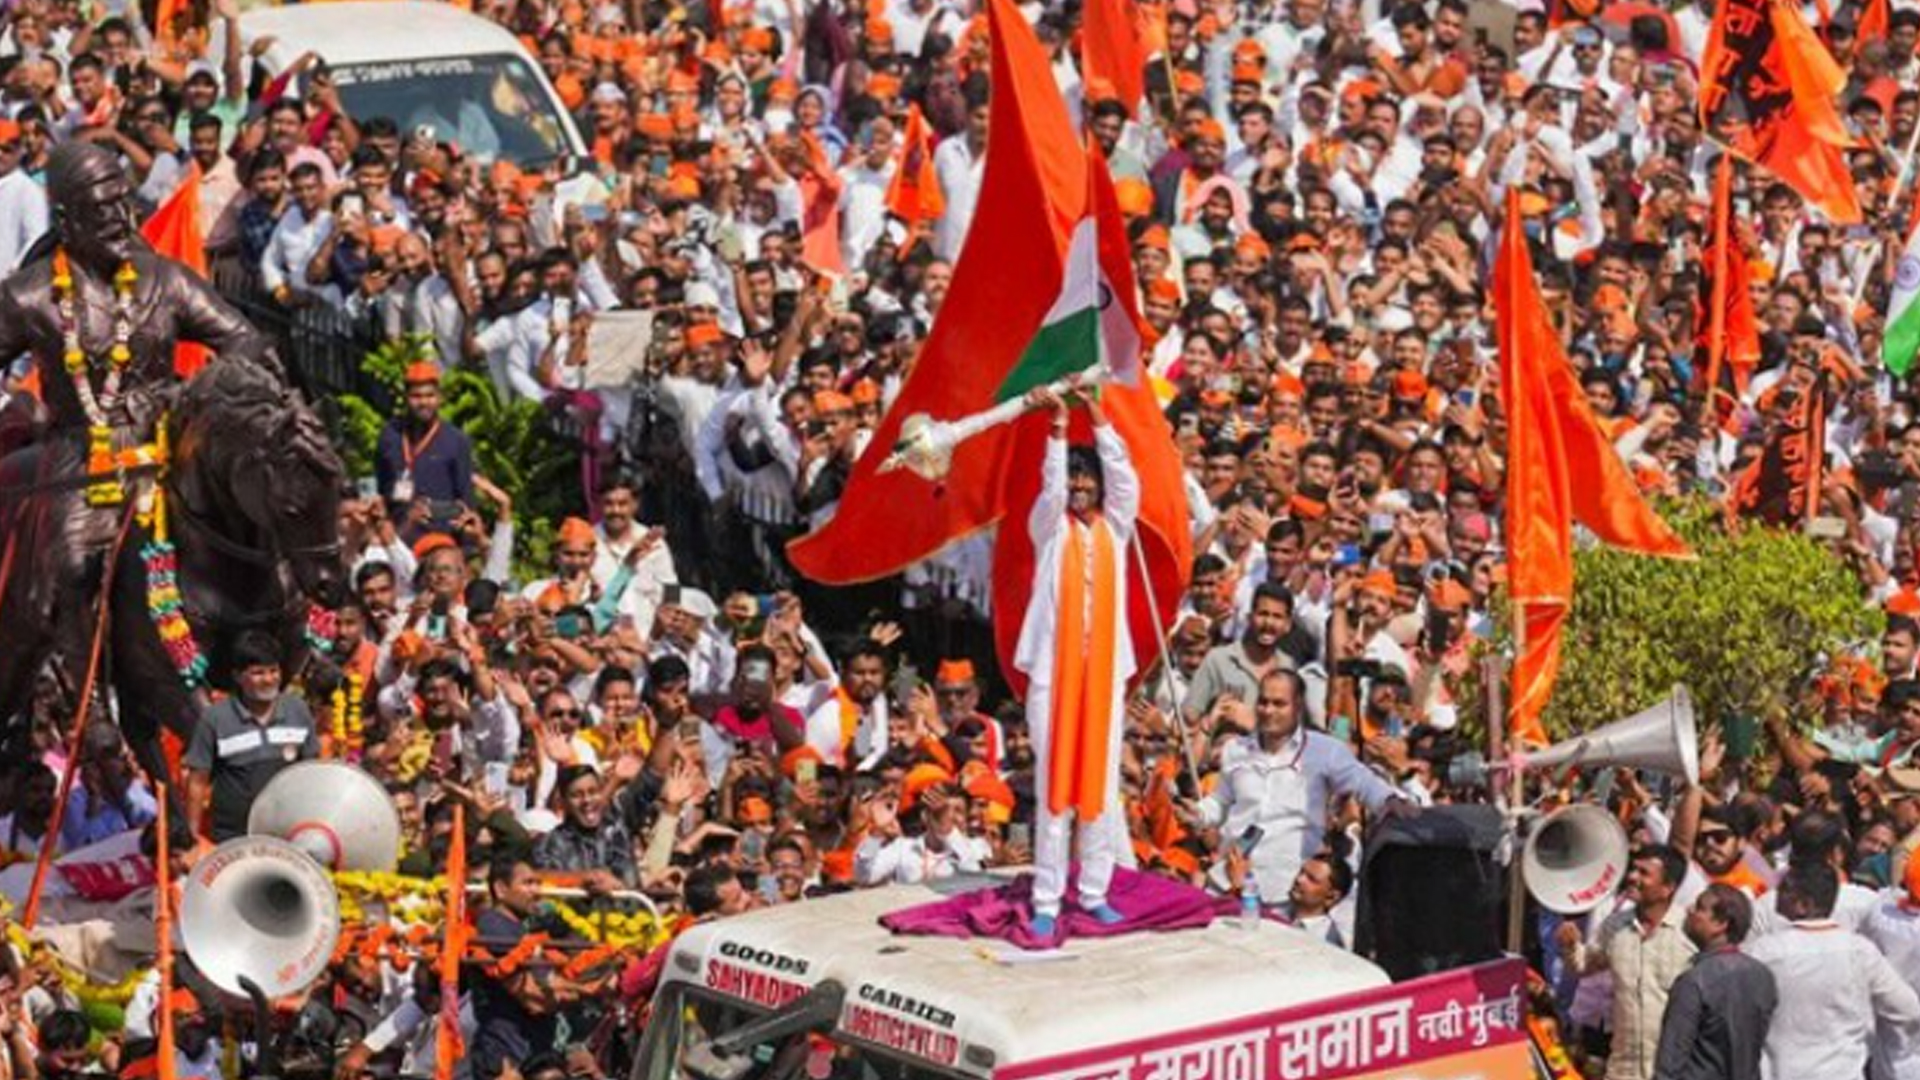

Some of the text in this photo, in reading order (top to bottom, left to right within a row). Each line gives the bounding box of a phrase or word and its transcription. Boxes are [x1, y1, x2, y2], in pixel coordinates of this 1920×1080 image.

[720, 941, 955, 1028] GOODS CARRIER
[1276, 997, 1413, 1079] समाज
[1417, 999, 1464, 1042] नवी
[1467, 984, 1520, 1046] मुंबई
